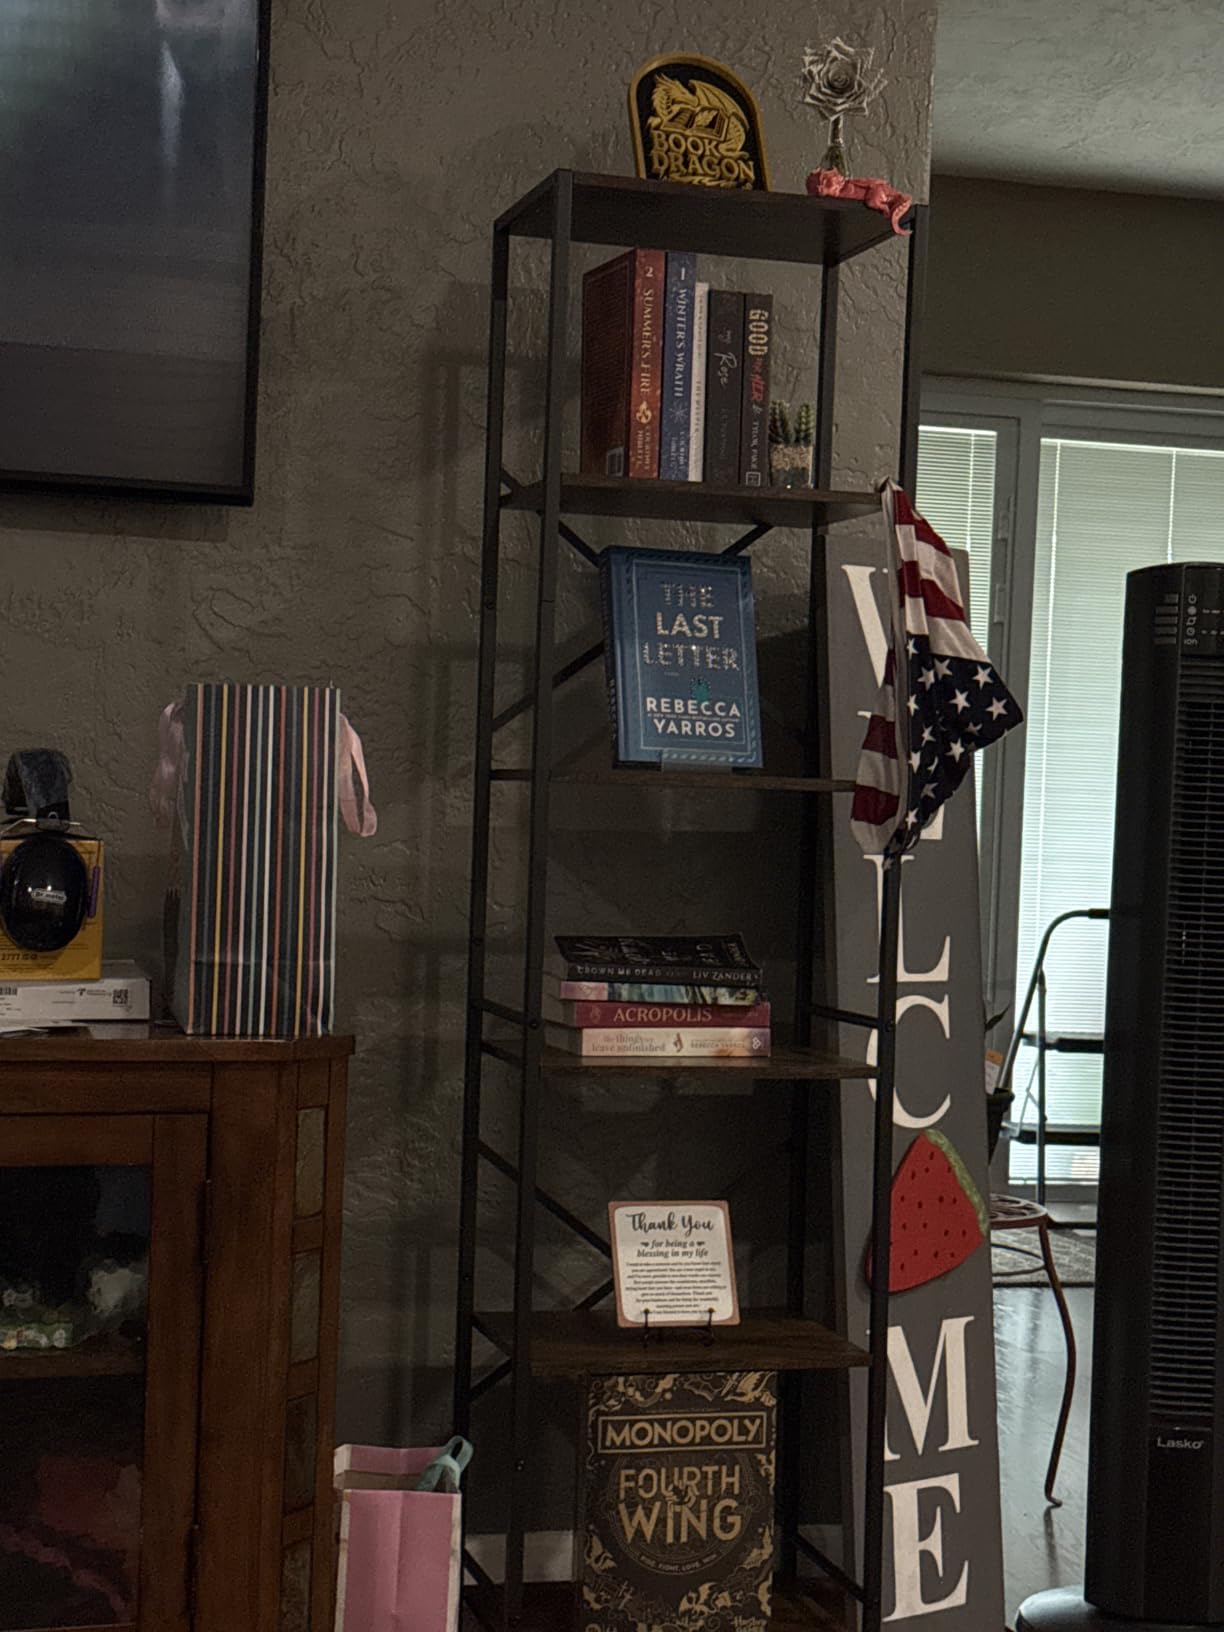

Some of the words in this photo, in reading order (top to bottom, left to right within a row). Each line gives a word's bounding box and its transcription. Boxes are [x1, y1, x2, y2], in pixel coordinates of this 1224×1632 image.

[651, 130, 718, 158] BOOK
[650, 152, 755, 182] DRAGON
[645, 267, 653, 278] 2
[641, 289, 655, 359] SUMMER'S
[675, 289, 688, 349] WINTER'S
[748, 309, 769, 356] GOOD
[639, 361, 651, 394] FIRE
[673, 353, 685, 398] WRATH
[713, 352, 738, 385] Rose
[750, 374, 765, 401] HER
[660, 584, 715, 608] THE
[656, 612, 724, 639] LAST
[642, 641, 740, 671] LETTER
[646, 697, 741, 718] REBECCA
[653, 718, 736, 738] YARROS
[692, 971, 709, 980] LIV
[712, 971, 752, 981] ZANDER
[613, 1006, 712, 1023] ACROPOLIS
[625, 1212, 678, 1233] Thank
[681, 1214, 714, 1237] You
[636, 1248, 669, 1258] blessing
[671, 1248, 680, 1257] in
[681, 1249, 693, 1259] my
[695, 1247, 709, 1258] life
[651, 1239, 664, 1249] for
[665, 1239, 688, 1249] being
[604, 1417, 761, 1447] MONOPOLY
[1156, 1435, 1205, 1450] Lasko
[619, 1464, 741, 1500] FOURTH
[618, 1499, 742, 1543] WING
